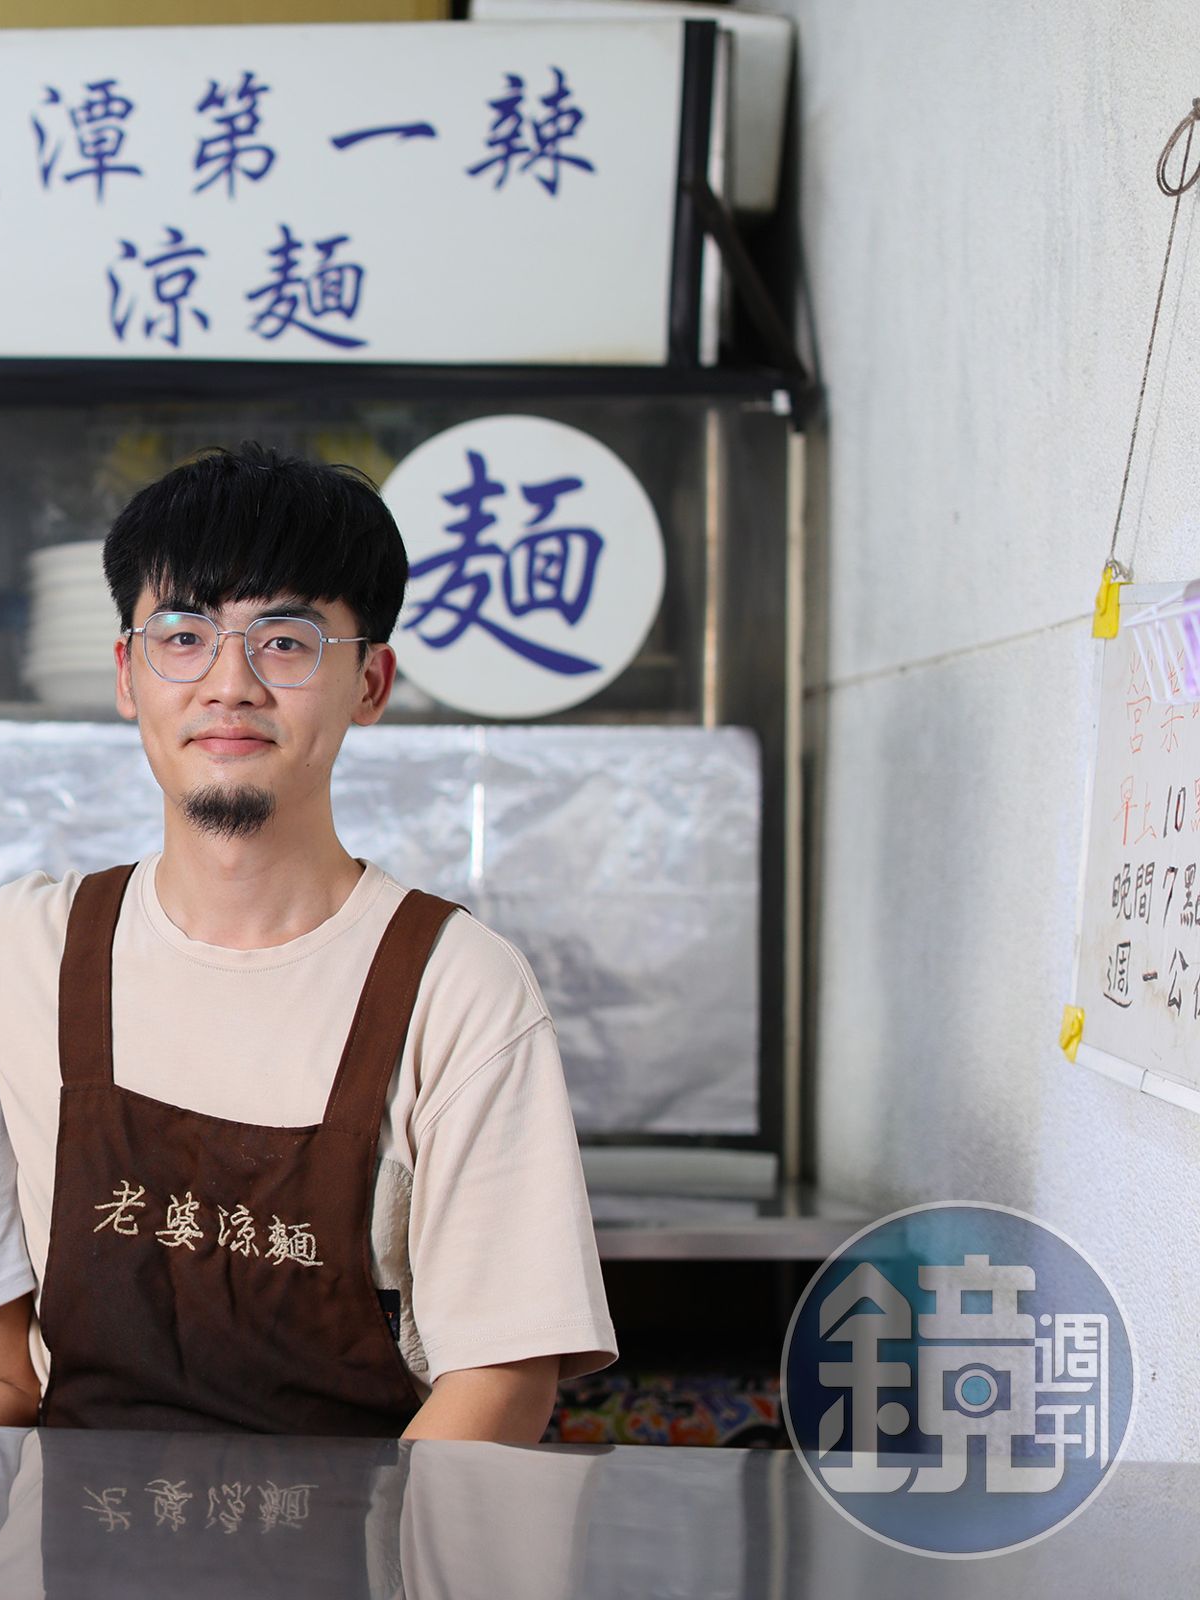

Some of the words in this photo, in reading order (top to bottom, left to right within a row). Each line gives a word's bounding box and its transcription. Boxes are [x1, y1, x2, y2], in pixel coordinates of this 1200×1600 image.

[1112, 774, 1200, 846] 早上10
[1103, 940, 1200, 1018] 週一公
[93, 1179, 324, 1267] 老婆涼麵
